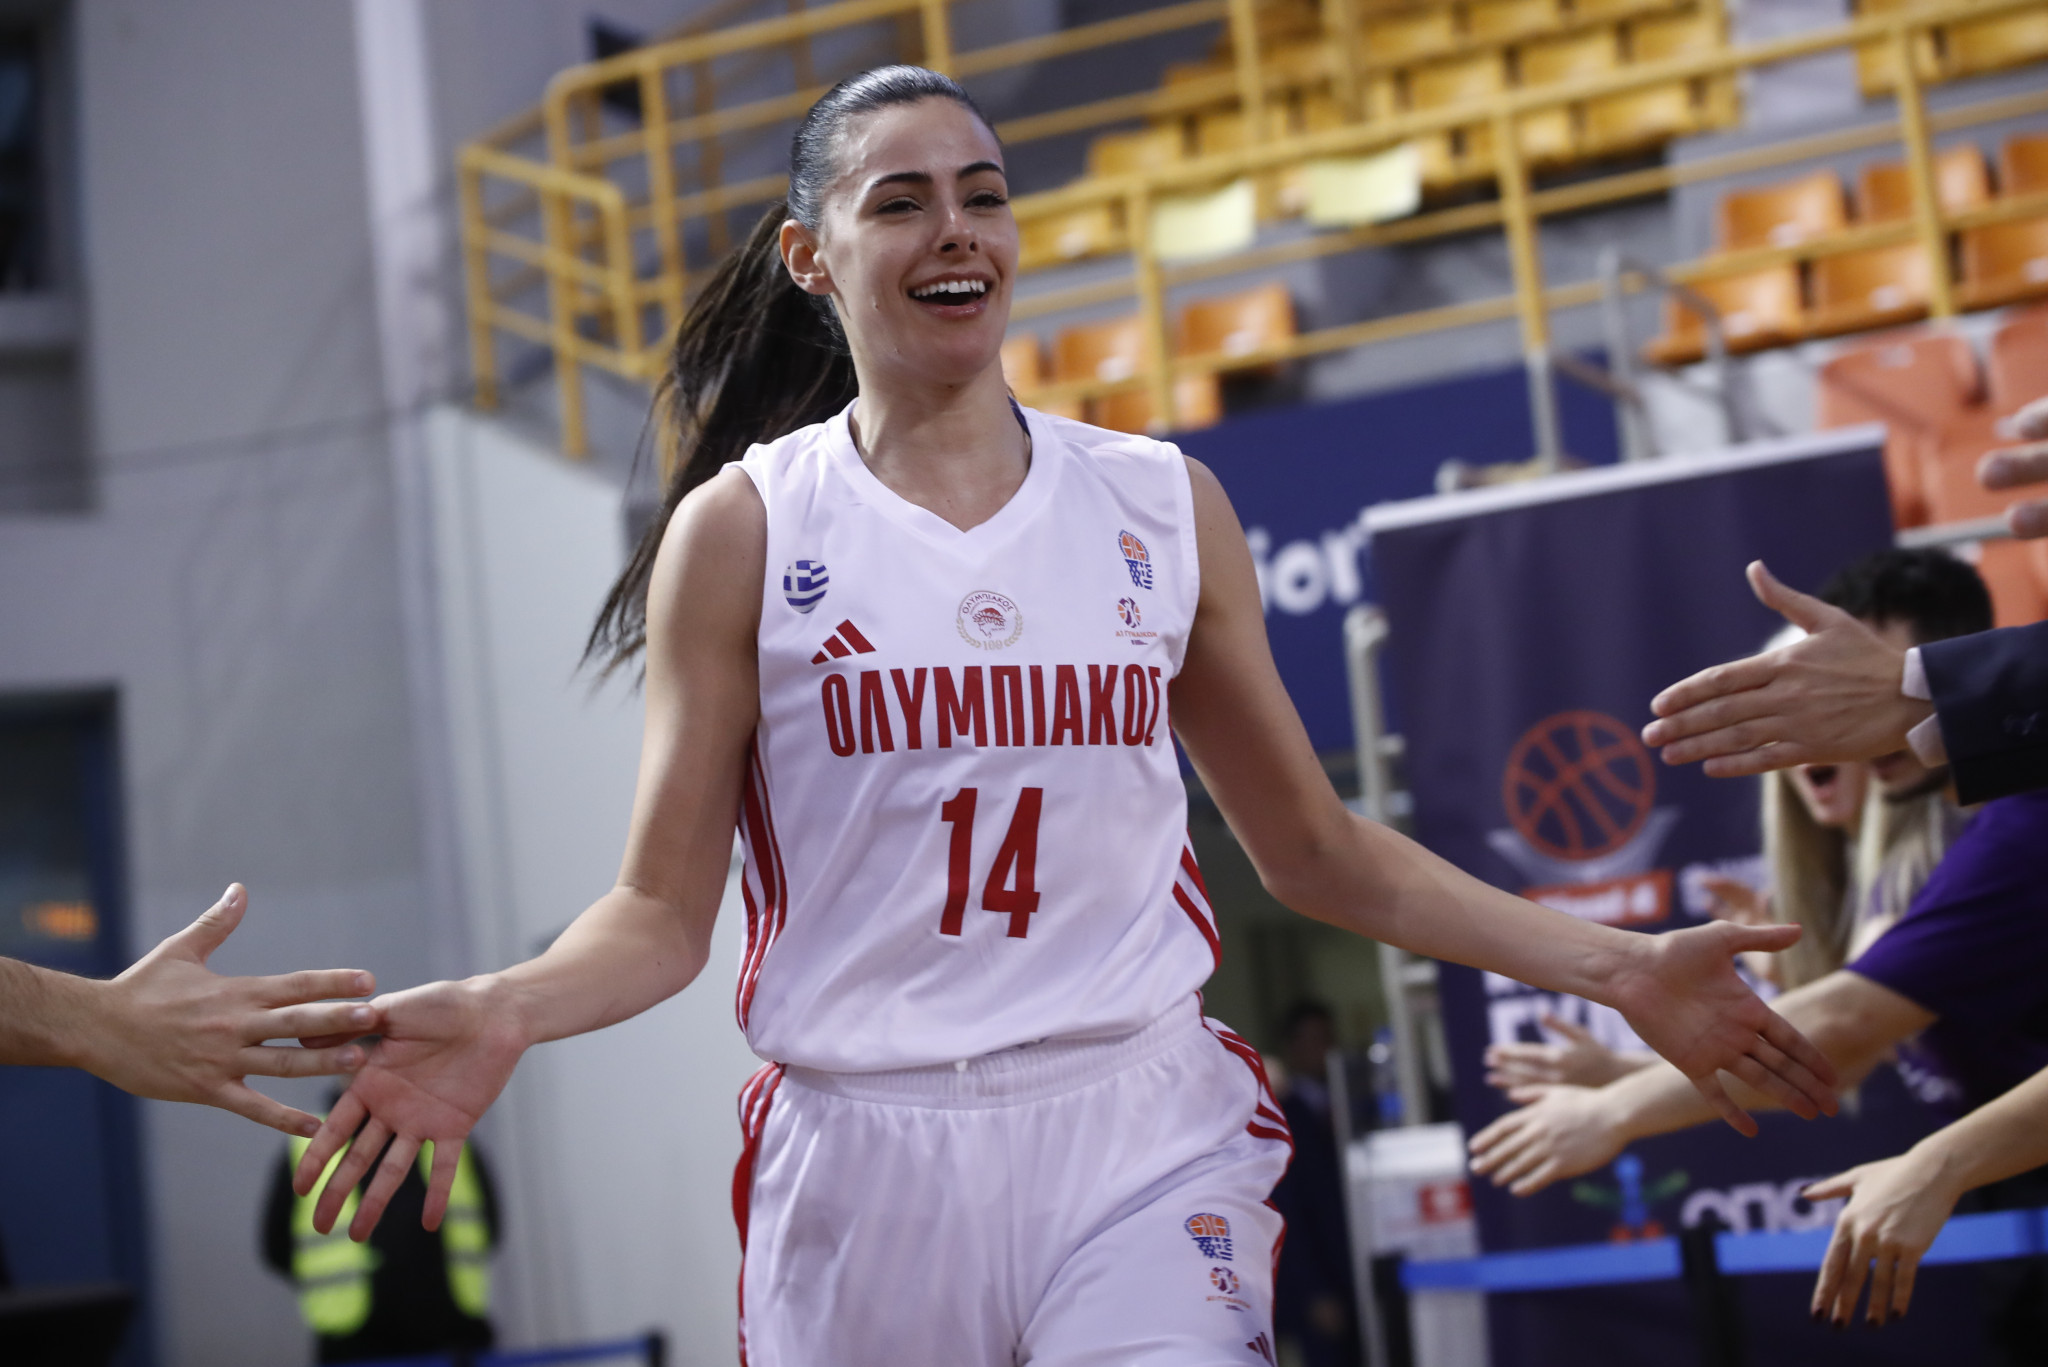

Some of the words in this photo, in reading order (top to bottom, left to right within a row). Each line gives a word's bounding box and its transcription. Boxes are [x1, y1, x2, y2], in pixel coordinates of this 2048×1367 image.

[962, 593, 1014, 614] ΟΛΥΜΠΙΑΚΟΣ
[983, 640, 1003, 651] 100
[821, 663, 1162, 757] ΟΛΥΜΠΙΑΚΟΣ
[940, 787, 1043, 939] 14
